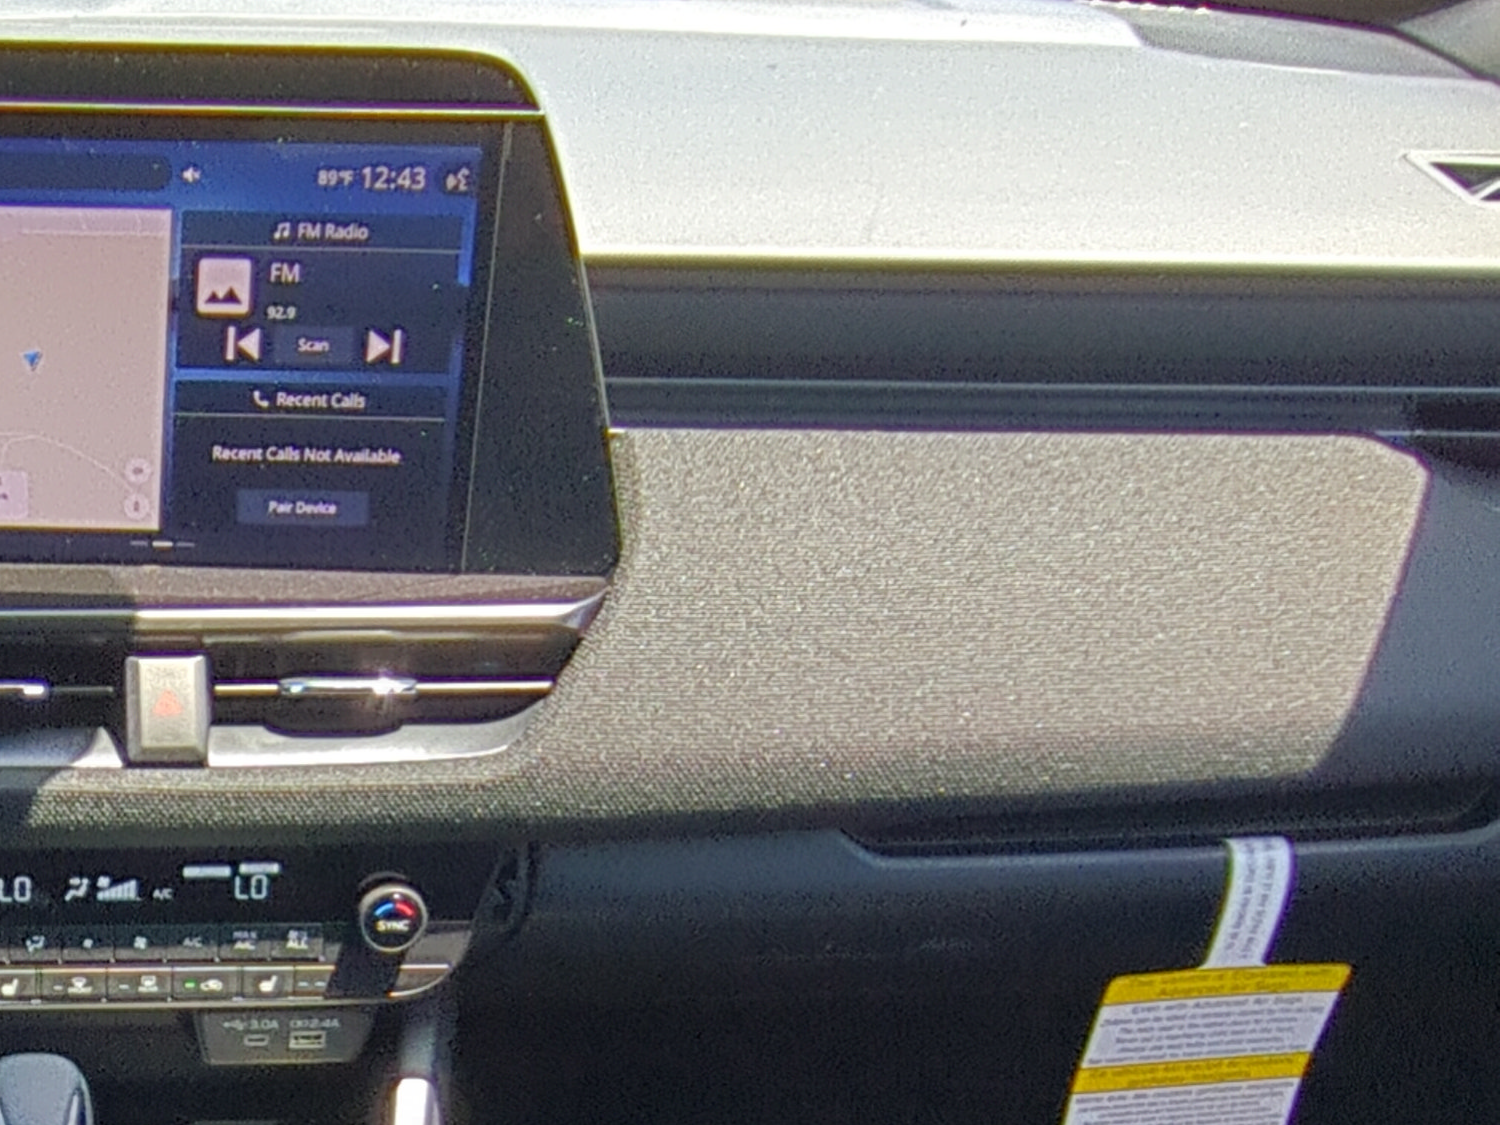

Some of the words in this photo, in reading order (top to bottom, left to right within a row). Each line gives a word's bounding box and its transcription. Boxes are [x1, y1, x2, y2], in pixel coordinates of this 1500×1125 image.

[361, 166, 426, 189] 12:43
[297, 222, 321, 239] FM
[325, 223, 369, 240] Radio
[269, 262, 300, 283] FM
[266, 305, 296, 320] 92.9
[297, 338, 330, 352] Scan
[275, 391, 327, 408] Recent
[331, 392, 366, 409] Calls
[211, 445, 263, 462] Recent
[266, 445, 300, 462] Calls
[303, 447, 331, 463] Not
[333, 448, 402, 464] Available
[268, 500, 292, 515] Pair
[295, 501, 337, 515] Device
[152, 887, 173, 900] A/C
[234, 874, 269, 900] LO
[376, 919, 411, 932] SYNC
